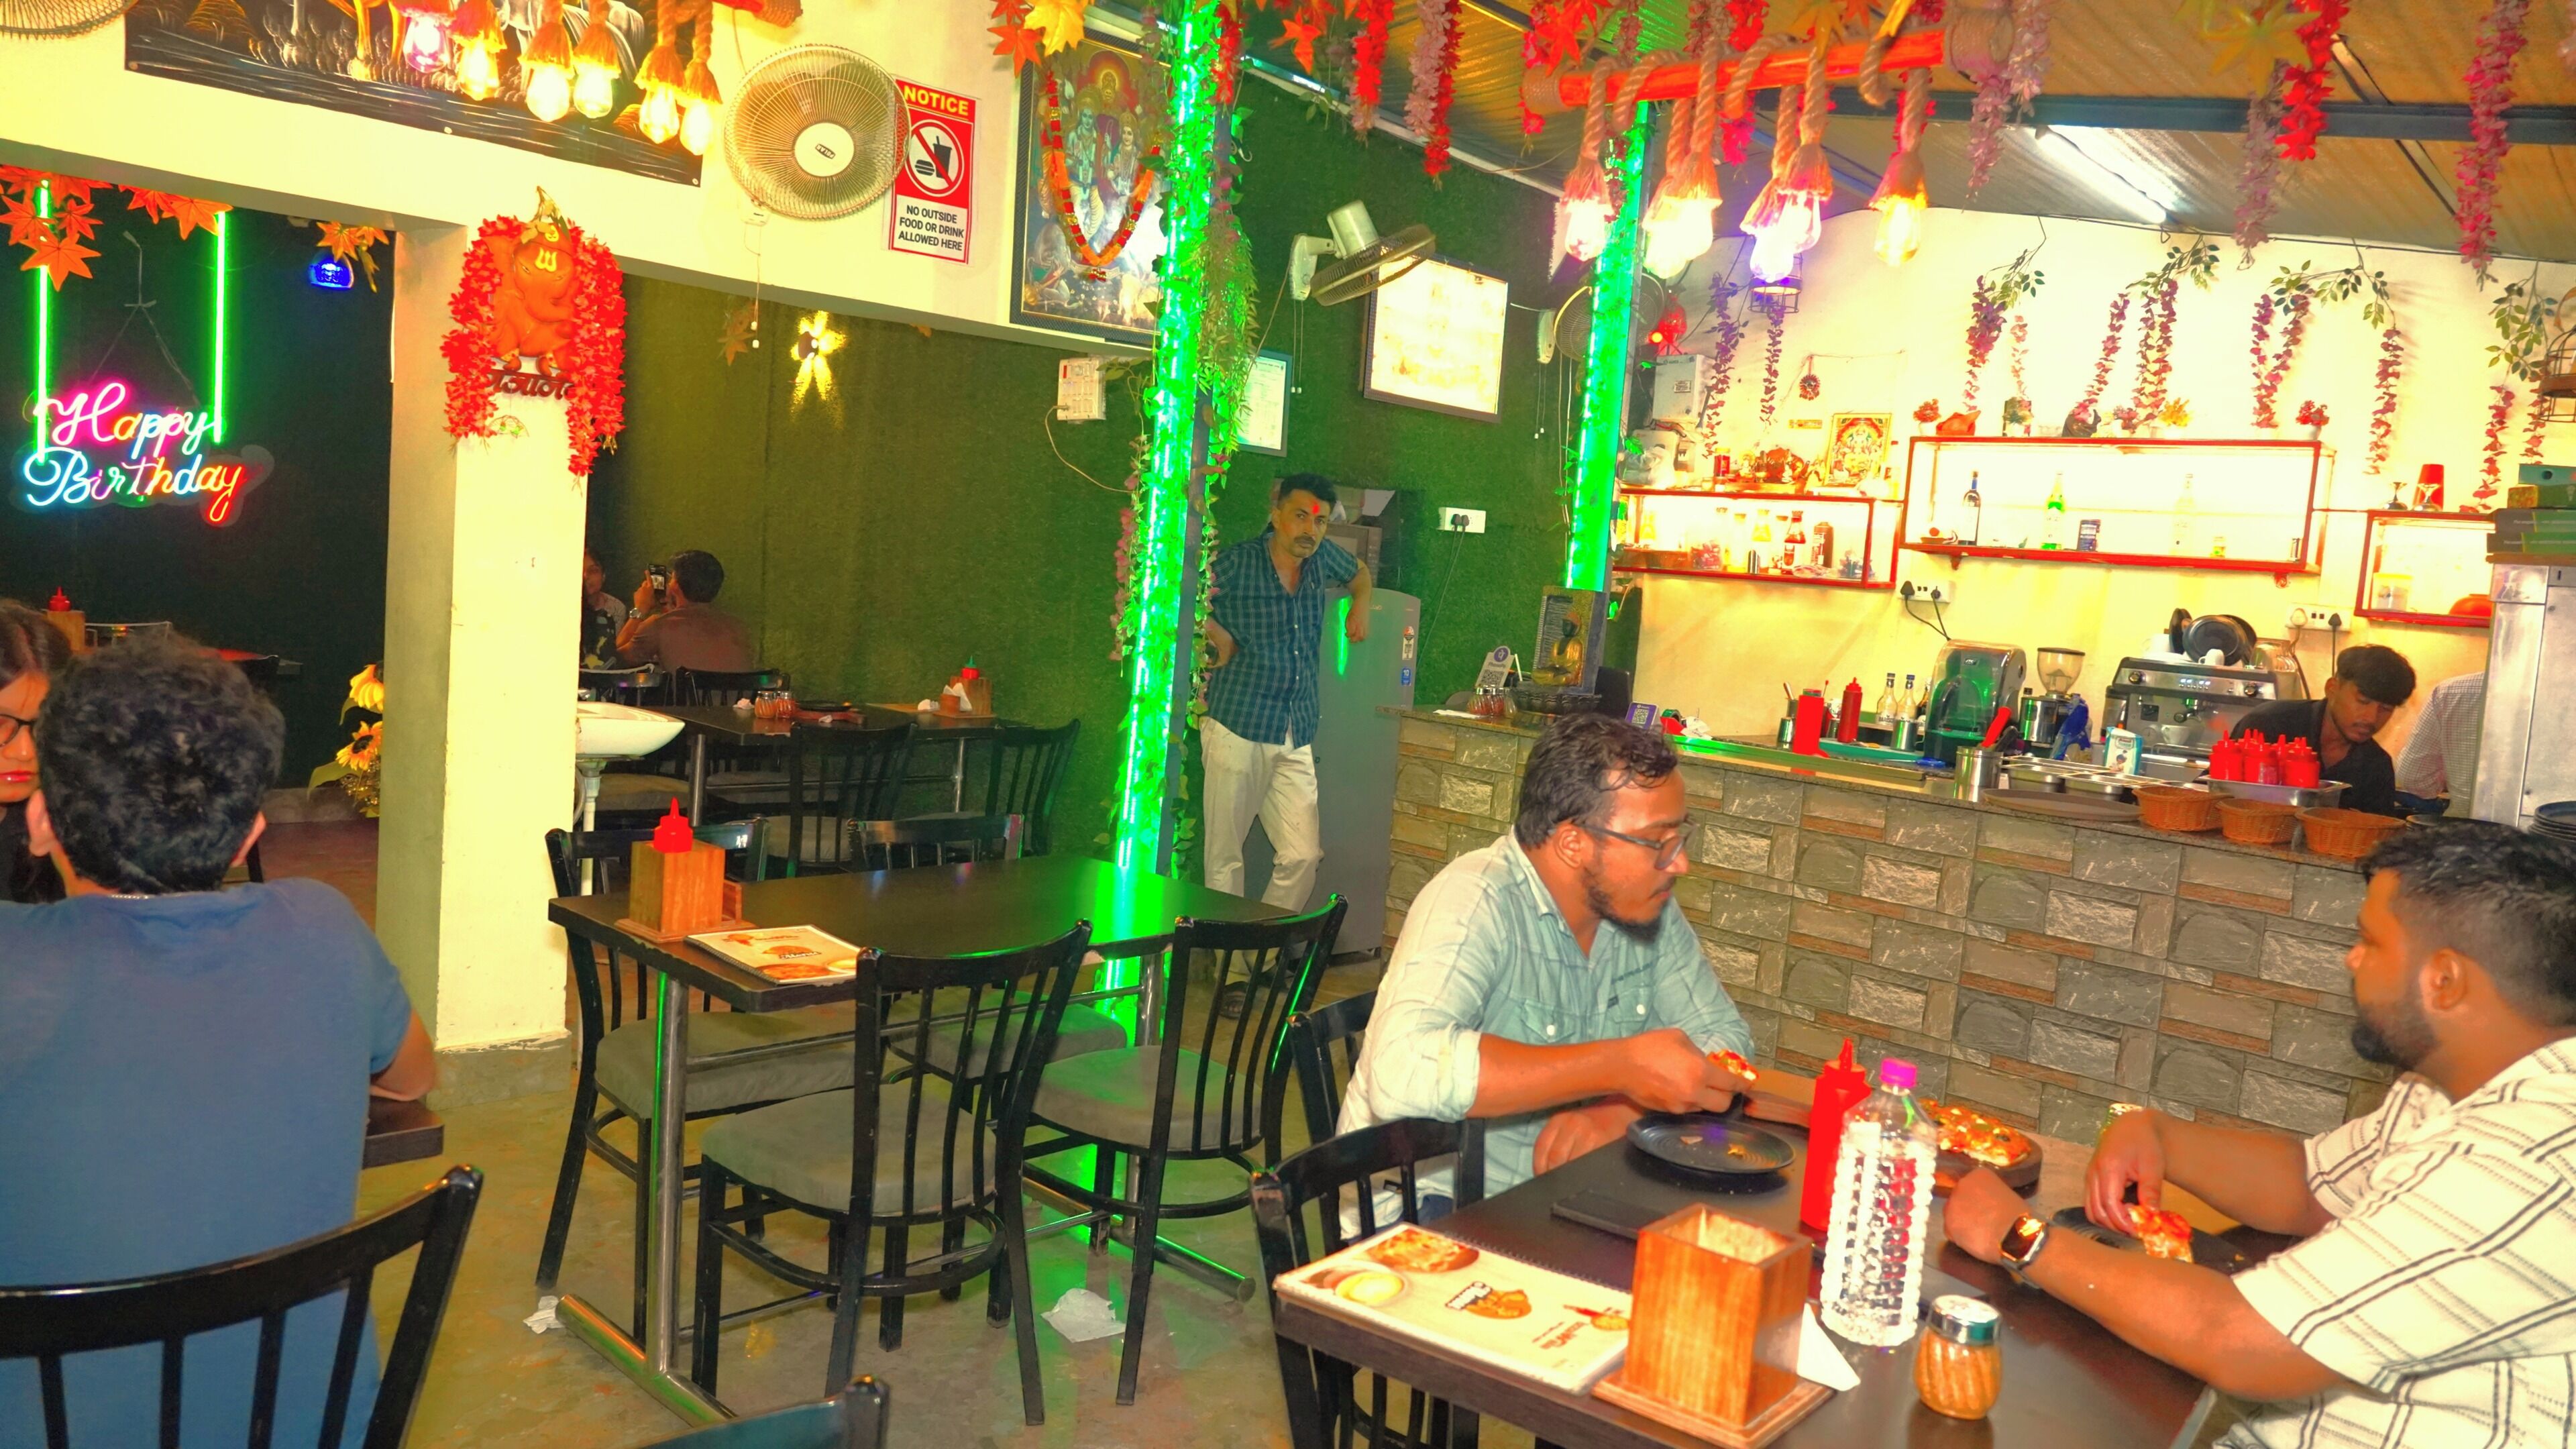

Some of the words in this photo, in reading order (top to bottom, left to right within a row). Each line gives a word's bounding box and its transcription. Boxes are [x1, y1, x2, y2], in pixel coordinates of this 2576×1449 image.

[904, 85, 969, 115] NOTICE
[816, 144, 835, 158] POLAR
[906, 205, 920, 216] NO
[922, 207, 957, 223] OUTSIDE
[900, 217, 923, 230] FOOD
[925, 222, 937, 233] OR
[938, 225, 964, 238] DRINK
[898, 231, 939, 246] ALLOWED
[941, 239, 963, 251] HERE
[34, 382, 213, 460] Happy
[24, 446, 245, 522] Birthday
